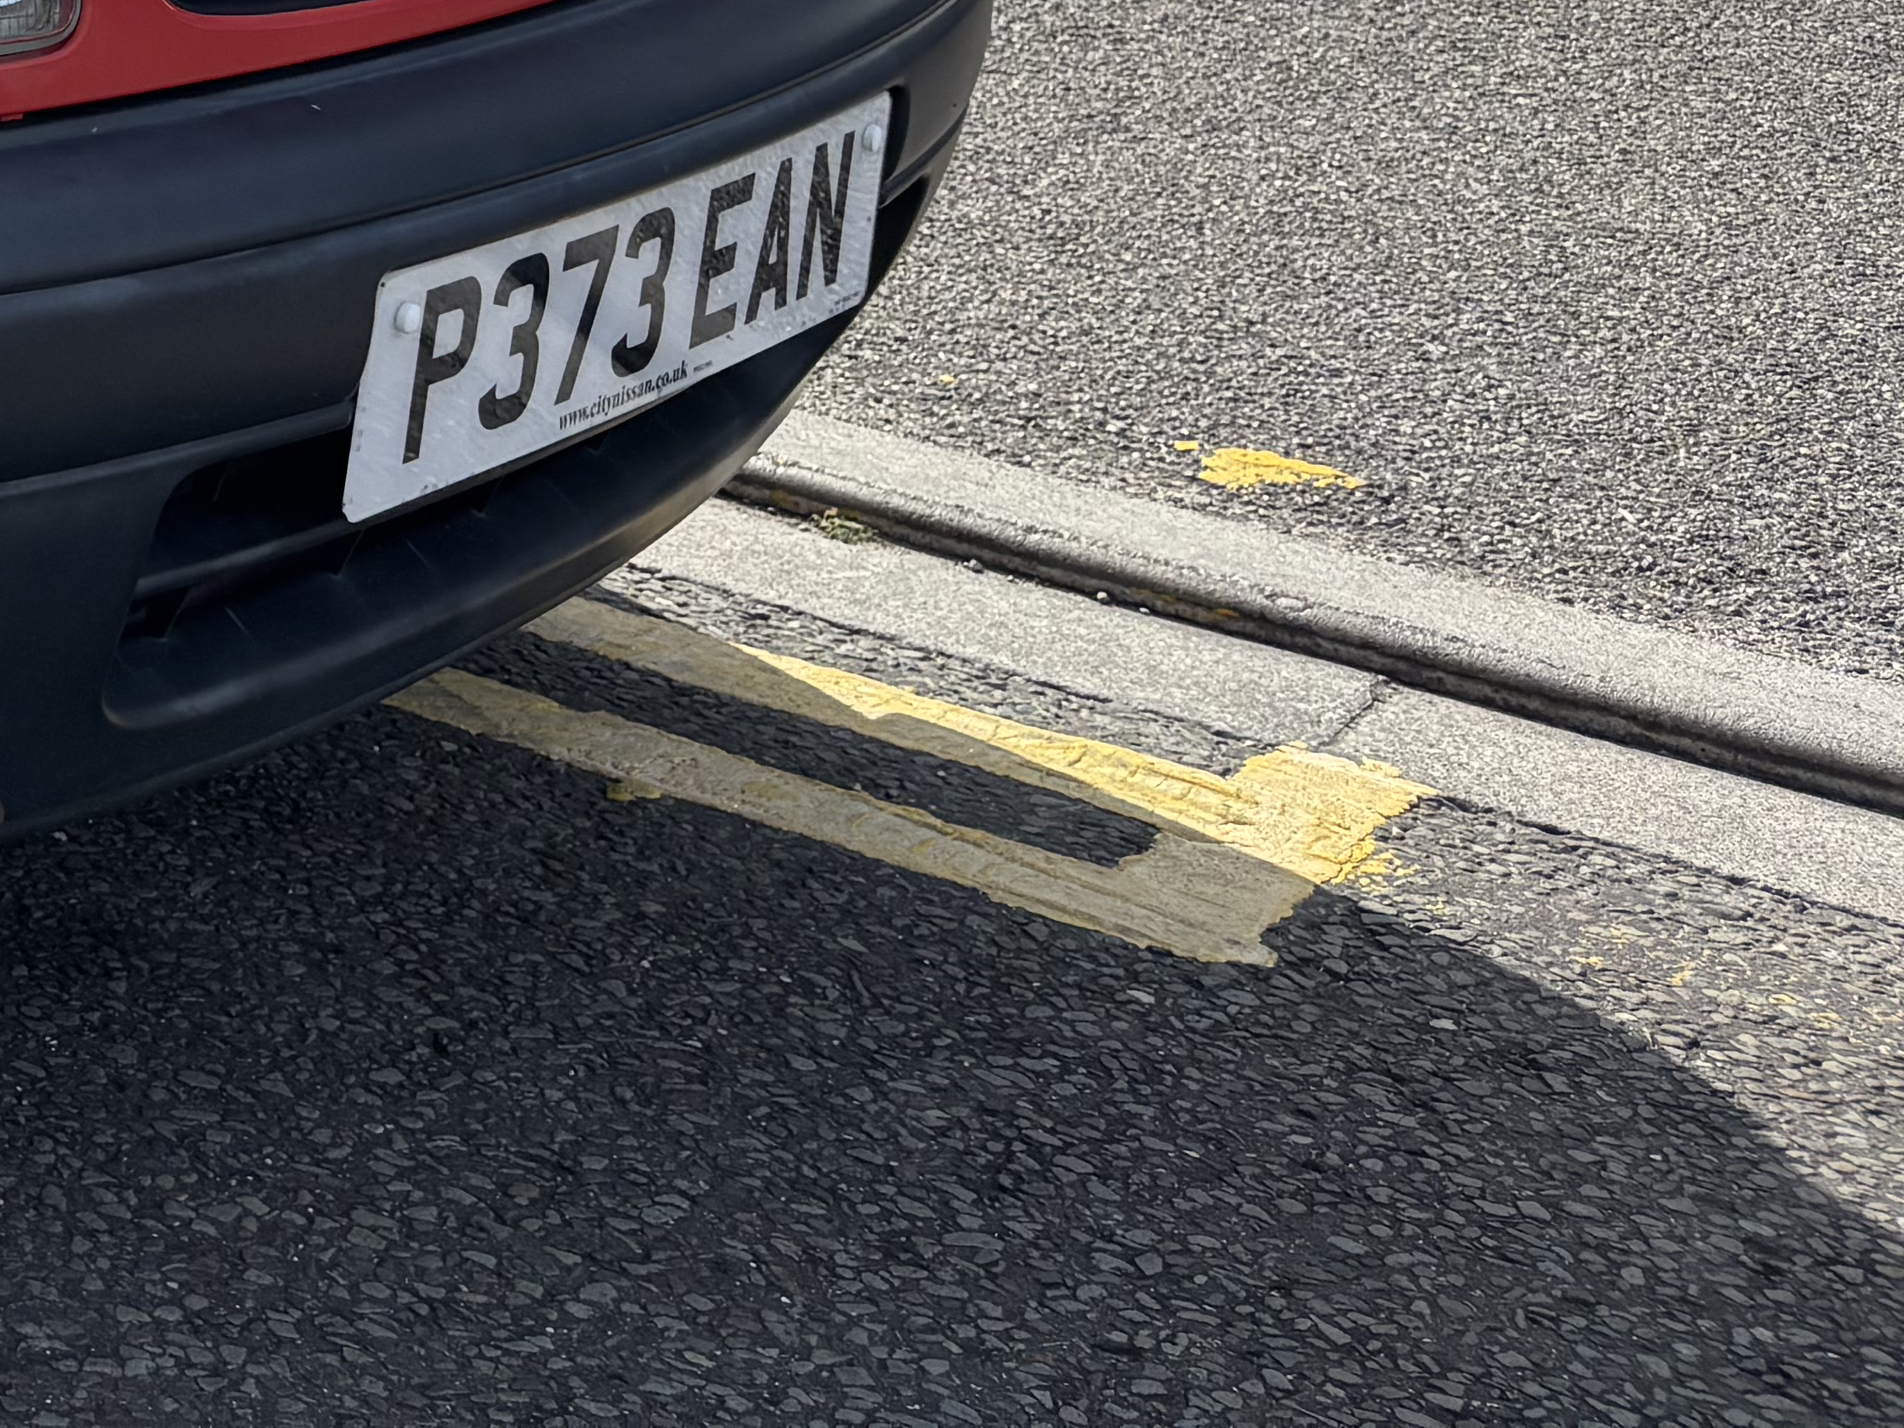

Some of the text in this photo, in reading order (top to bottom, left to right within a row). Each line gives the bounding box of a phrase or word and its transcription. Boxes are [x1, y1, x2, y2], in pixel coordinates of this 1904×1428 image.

[402, 130, 856, 465] P373 EAN
[559, 359, 689, 431] www.citynissan.co.uk
